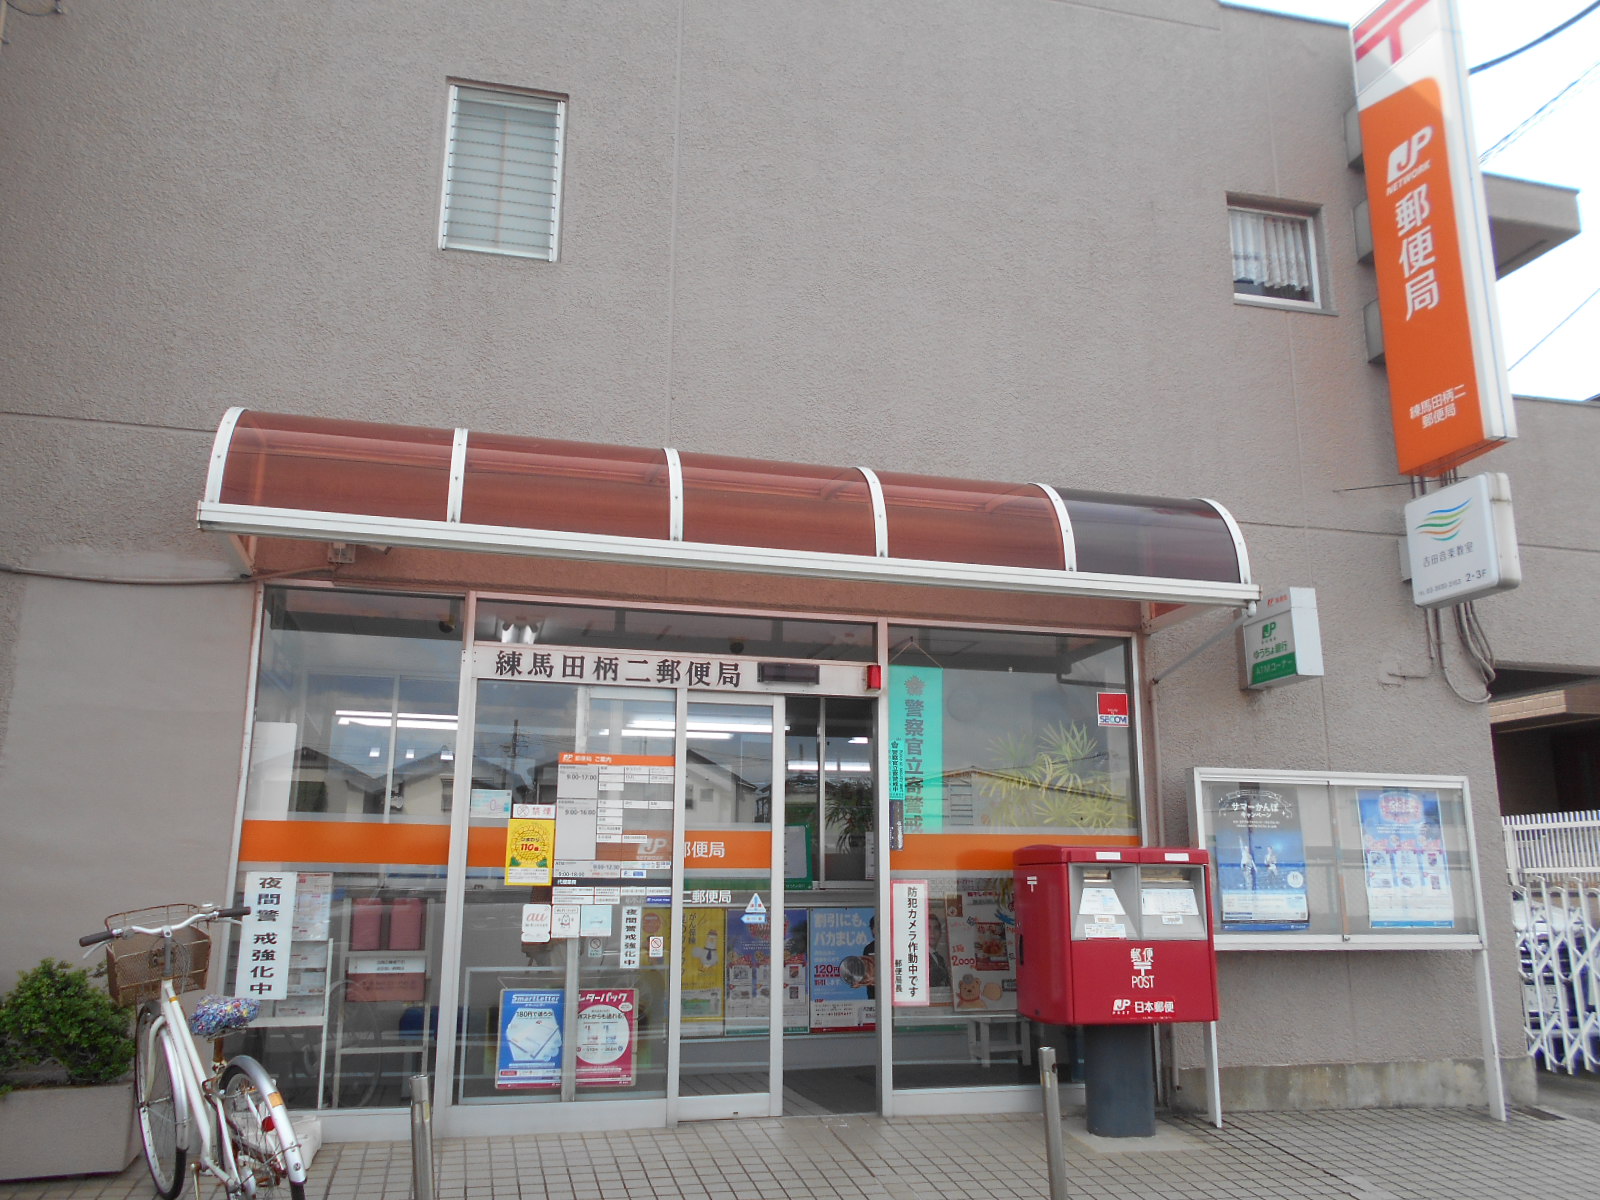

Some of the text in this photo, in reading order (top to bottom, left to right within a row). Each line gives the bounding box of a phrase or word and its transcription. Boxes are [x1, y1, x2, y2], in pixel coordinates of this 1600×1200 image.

[1386, 159, 1431, 197] NETWORK
[1395, 183, 1440, 321] 郵便局
[1409, 384, 1467, 419] 練馬田柄二
[1422, 402, 1456, 429] 郵便局
[1423, 541, 1473, 568] 吉田音楽教室
[1253, 641, 1288, 660] ゆうちょ銀行
[495, 650, 741, 688] 練馬田柄二郵便局
[1231, 802, 1279, 812] サマーかんぽ
[1240, 811, 1272, 819] キャンペーン
[526, 912, 547, 922] au
[250, 876, 284, 996] 夜間警戒強化中
[624, 908, 638, 966] 夜間警戒強化中
[907, 886, 919, 998] 防犯カメラ作動中です
[1130, 948, 1154, 963] 郵便
[1131, 975, 1155, 988] POST
[1134, 1001, 1175, 1013] 日本郵便
